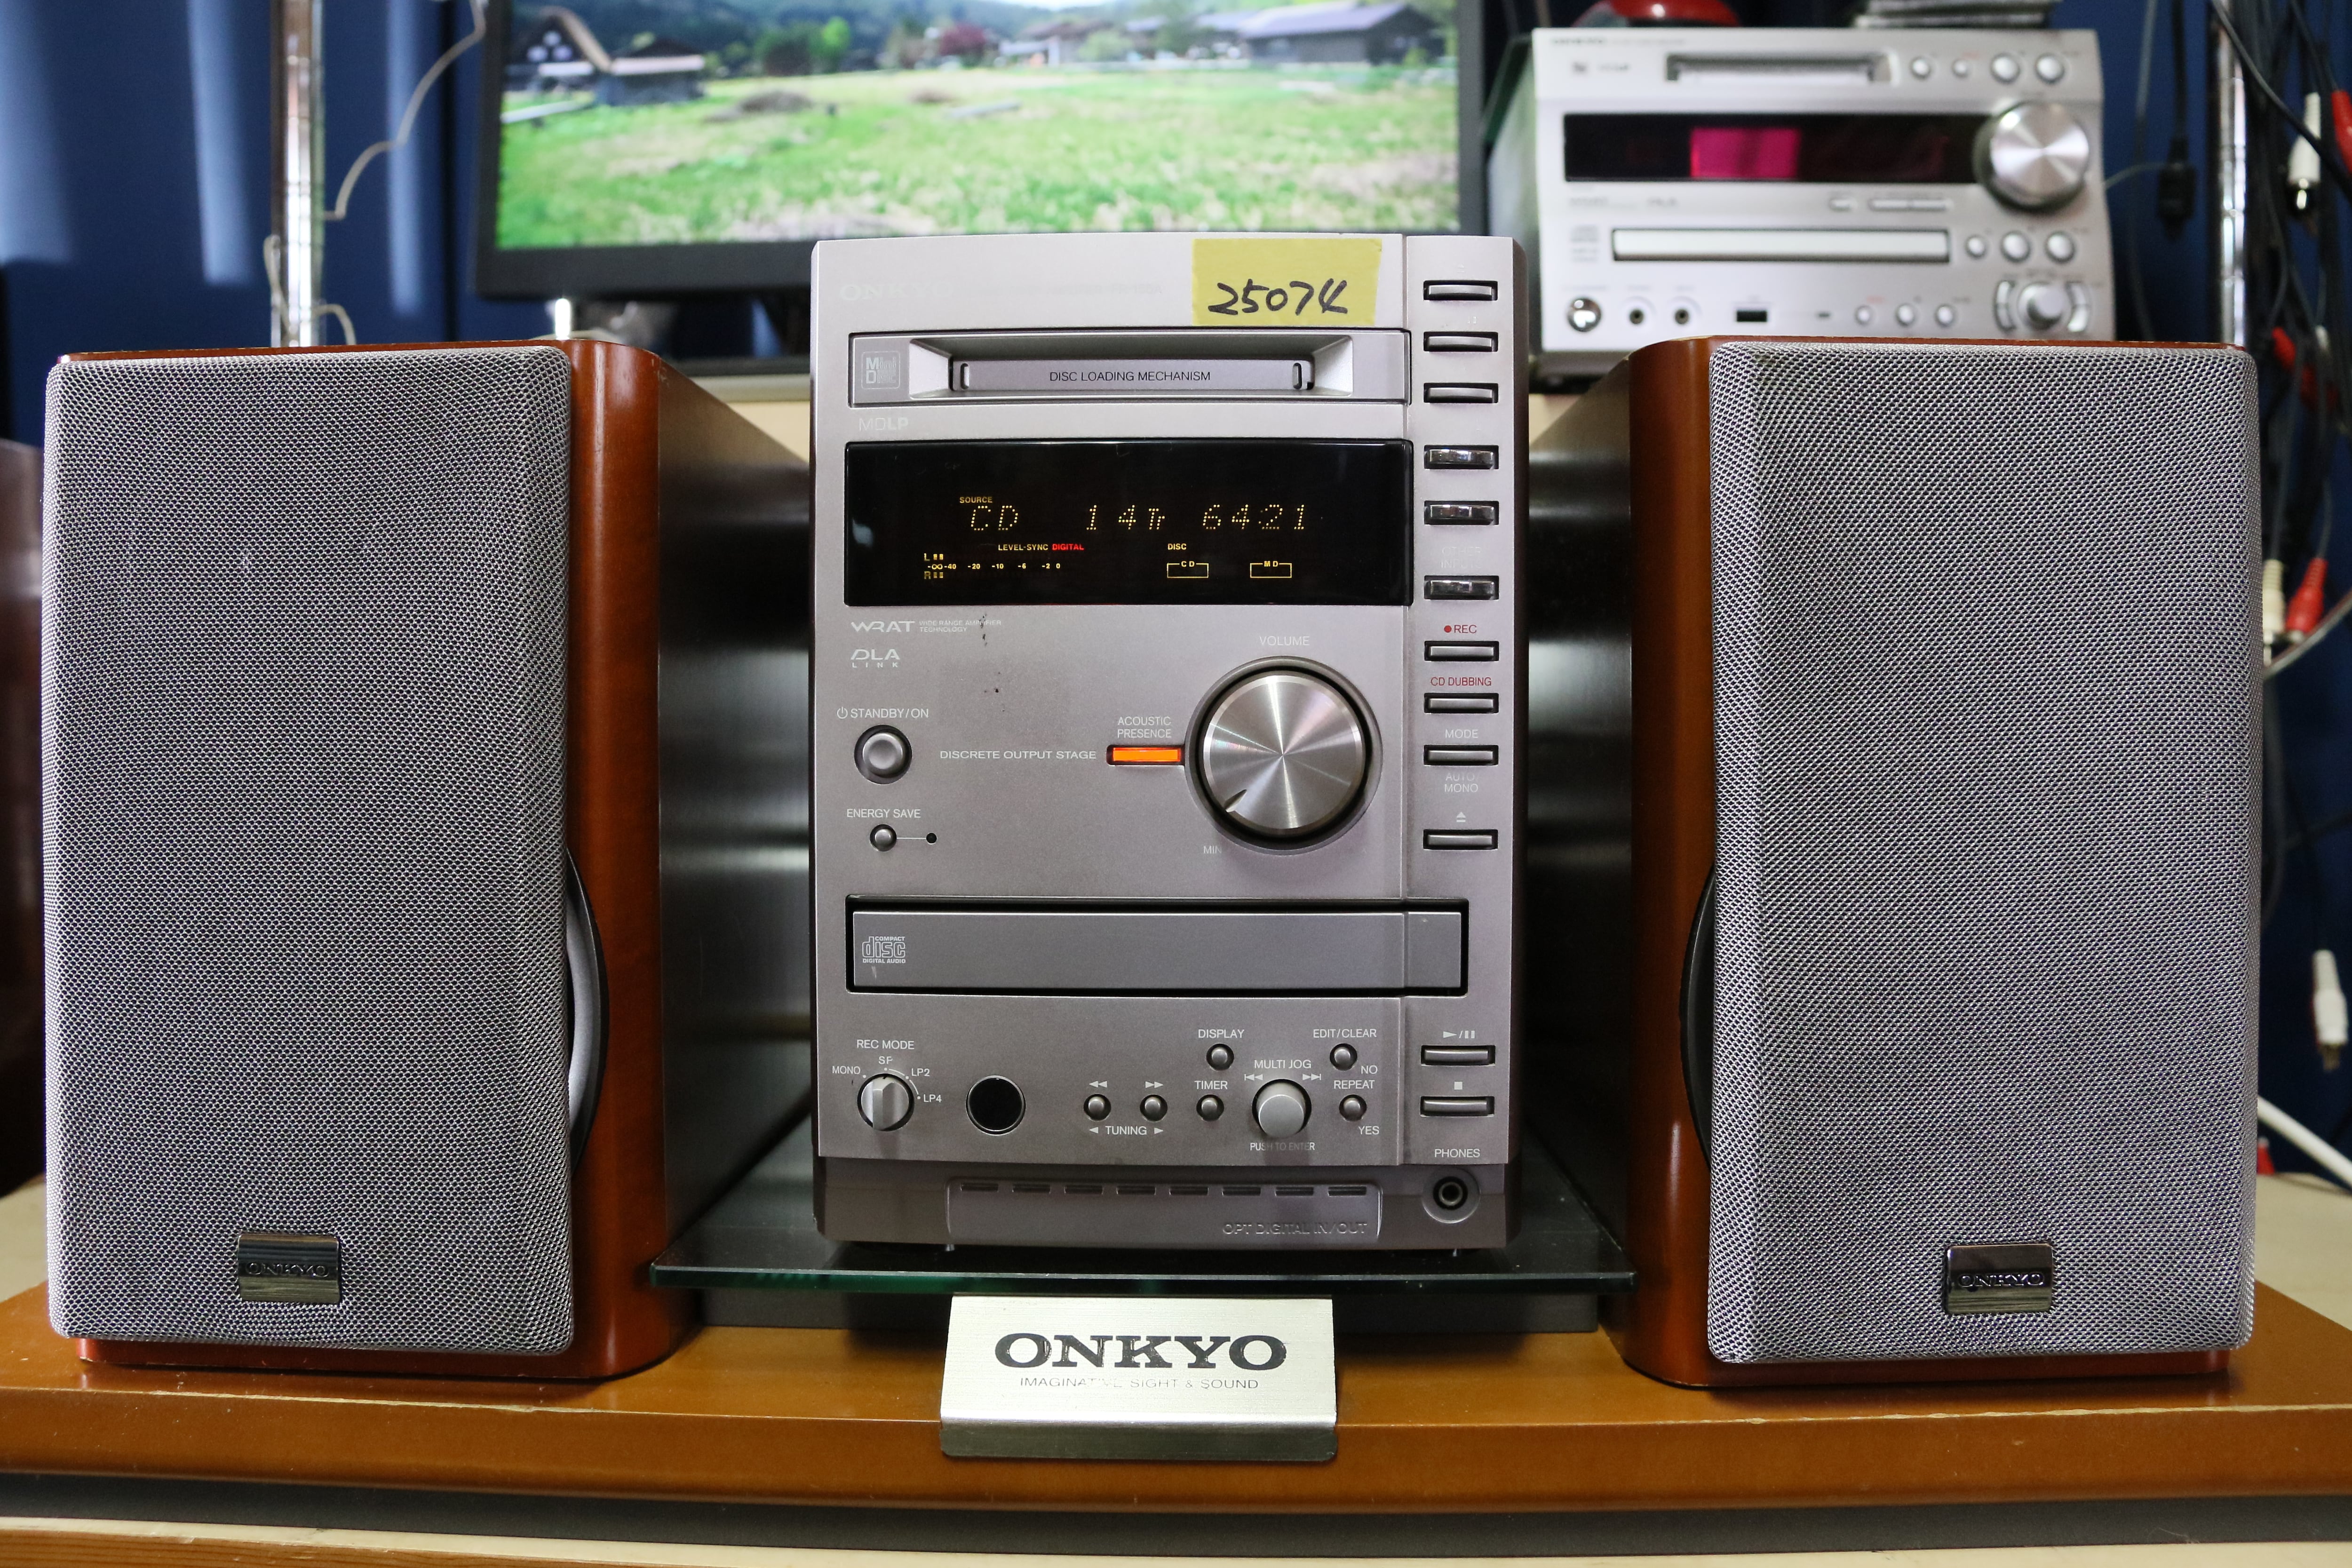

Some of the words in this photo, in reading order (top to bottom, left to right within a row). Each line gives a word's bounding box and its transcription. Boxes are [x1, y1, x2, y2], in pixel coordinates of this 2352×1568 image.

[1049, 371, 1078, 382] DISC
[1081, 371, 1134, 382] LOADING
[1138, 371, 1210, 382] MECHANISM
[859, 417, 908, 431] MDLP
[971, 505, 1018, 530] CD
[851, 621, 915, 632] WRAT
[1454, 625, 1477, 634] REC
[1260, 636, 1310, 646] VOLUME
[850, 649, 900, 660] DLA
[1430, 677, 1445, 686] CD
[1448, 677, 1492, 686] DUBBING
[850, 708, 929, 718] STANDBY/ON
[1118, 716, 1171, 726] ACOUSTIC
[1117, 729, 1172, 739] PRESENCE
[1445, 730, 1478, 738] MODE
[1445, 783, 1478, 793] MONO
[847, 809, 890, 818] ENERGY
[893, 809, 921, 818] SAVE
[1204, 845, 1222, 854] MIN
[1198, 1029, 1245, 1038] DISPLAY
[1313, 1029, 1377, 1038] EDIT/CLEAR
[857, 1039, 879, 1049] REC
[882, 1040, 914, 1050] MODE
[1254, 1059, 1285, 1069] MULTI
[1288, 1059, 1312, 1069] JOG
[1361, 1065, 1378, 1075] NO
[1195, 1081, 1228, 1090] TIMER
[1334, 1081, 1375, 1090] REPEAT
[923, 1094, 942, 1102] LP4
[1105, 1126, 1147, 1135] TUNING
[1359, 1126, 1380, 1135] YES
[1435, 1149, 1480, 1158] PHONES
[1223, 1224, 1252, 1234] OPT
[246, 1262, 329, 1278] ONKYO
[1959, 1272, 2044, 1288] ONKYO
[995, 1333, 1287, 1370] ONKYO
[1130, 1379, 1178, 1388] SIGHT
[1201, 1379, 1258, 1389] SOUND
